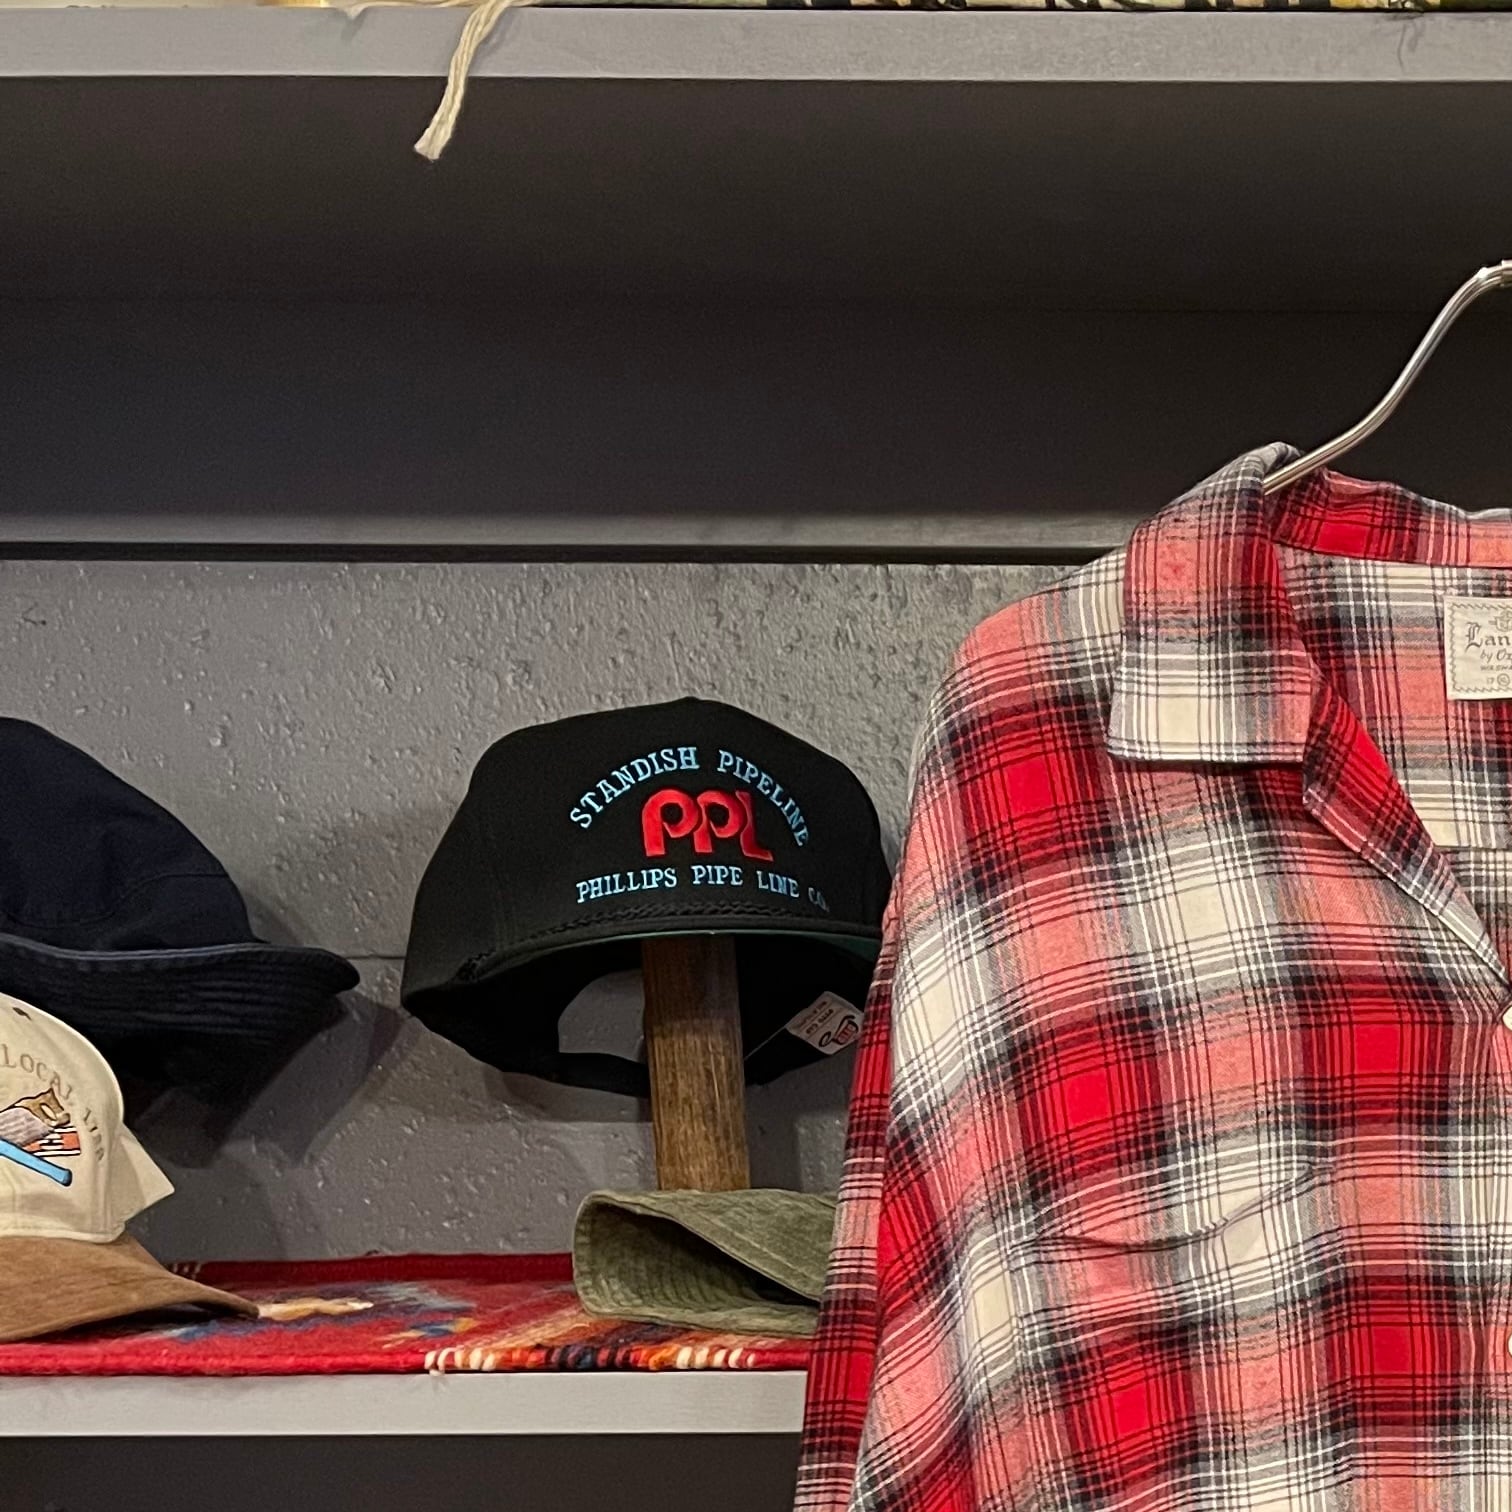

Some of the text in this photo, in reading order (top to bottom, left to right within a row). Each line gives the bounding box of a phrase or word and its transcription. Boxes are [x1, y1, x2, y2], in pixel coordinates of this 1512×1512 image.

[1480, 650, 1493, 663] by
[570, 747, 810, 847] STANDISH PIPELINE
[642, 789, 774, 861] PPL
[576, 868, 678, 904] PHILLIPS
[691, 865, 744, 886] PIPE
[756, 871, 799, 898] LINE
[0, 1043, 73, 1100] LOCAL
